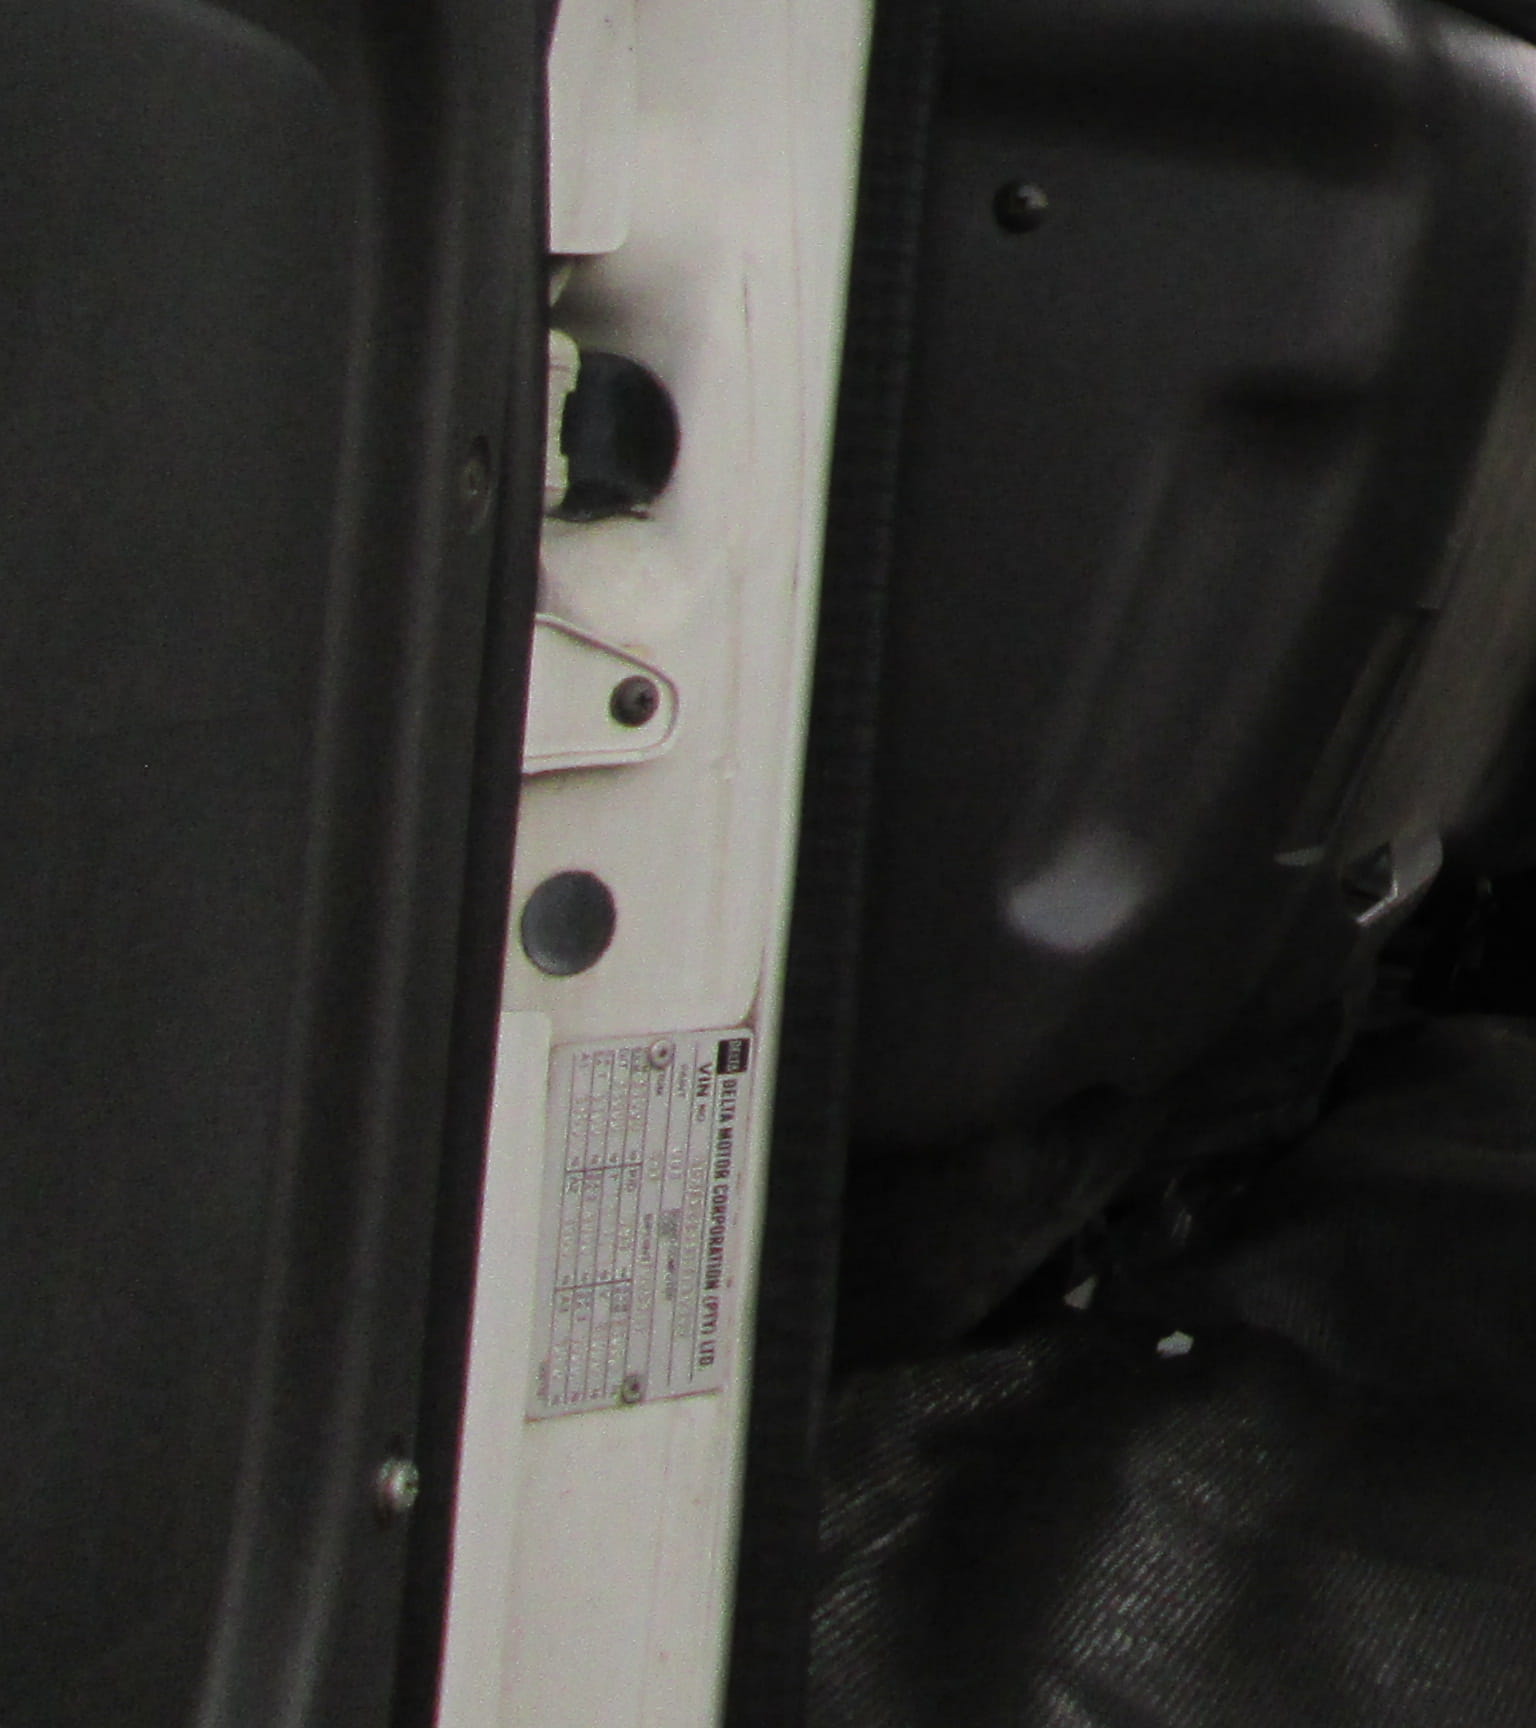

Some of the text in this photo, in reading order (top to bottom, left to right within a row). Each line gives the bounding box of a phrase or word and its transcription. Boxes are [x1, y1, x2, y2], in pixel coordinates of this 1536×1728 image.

[727, 1040, 741, 1072] DELTA
[696, 1063, 712, 1097] VIN
[716, 1079, 737, 1123] DELTA
[714, 1128, 733, 1179] MOTOR
[704, 1184, 728, 1289] CORPORATION
[700, 1297, 720, 1334] (PTY)
